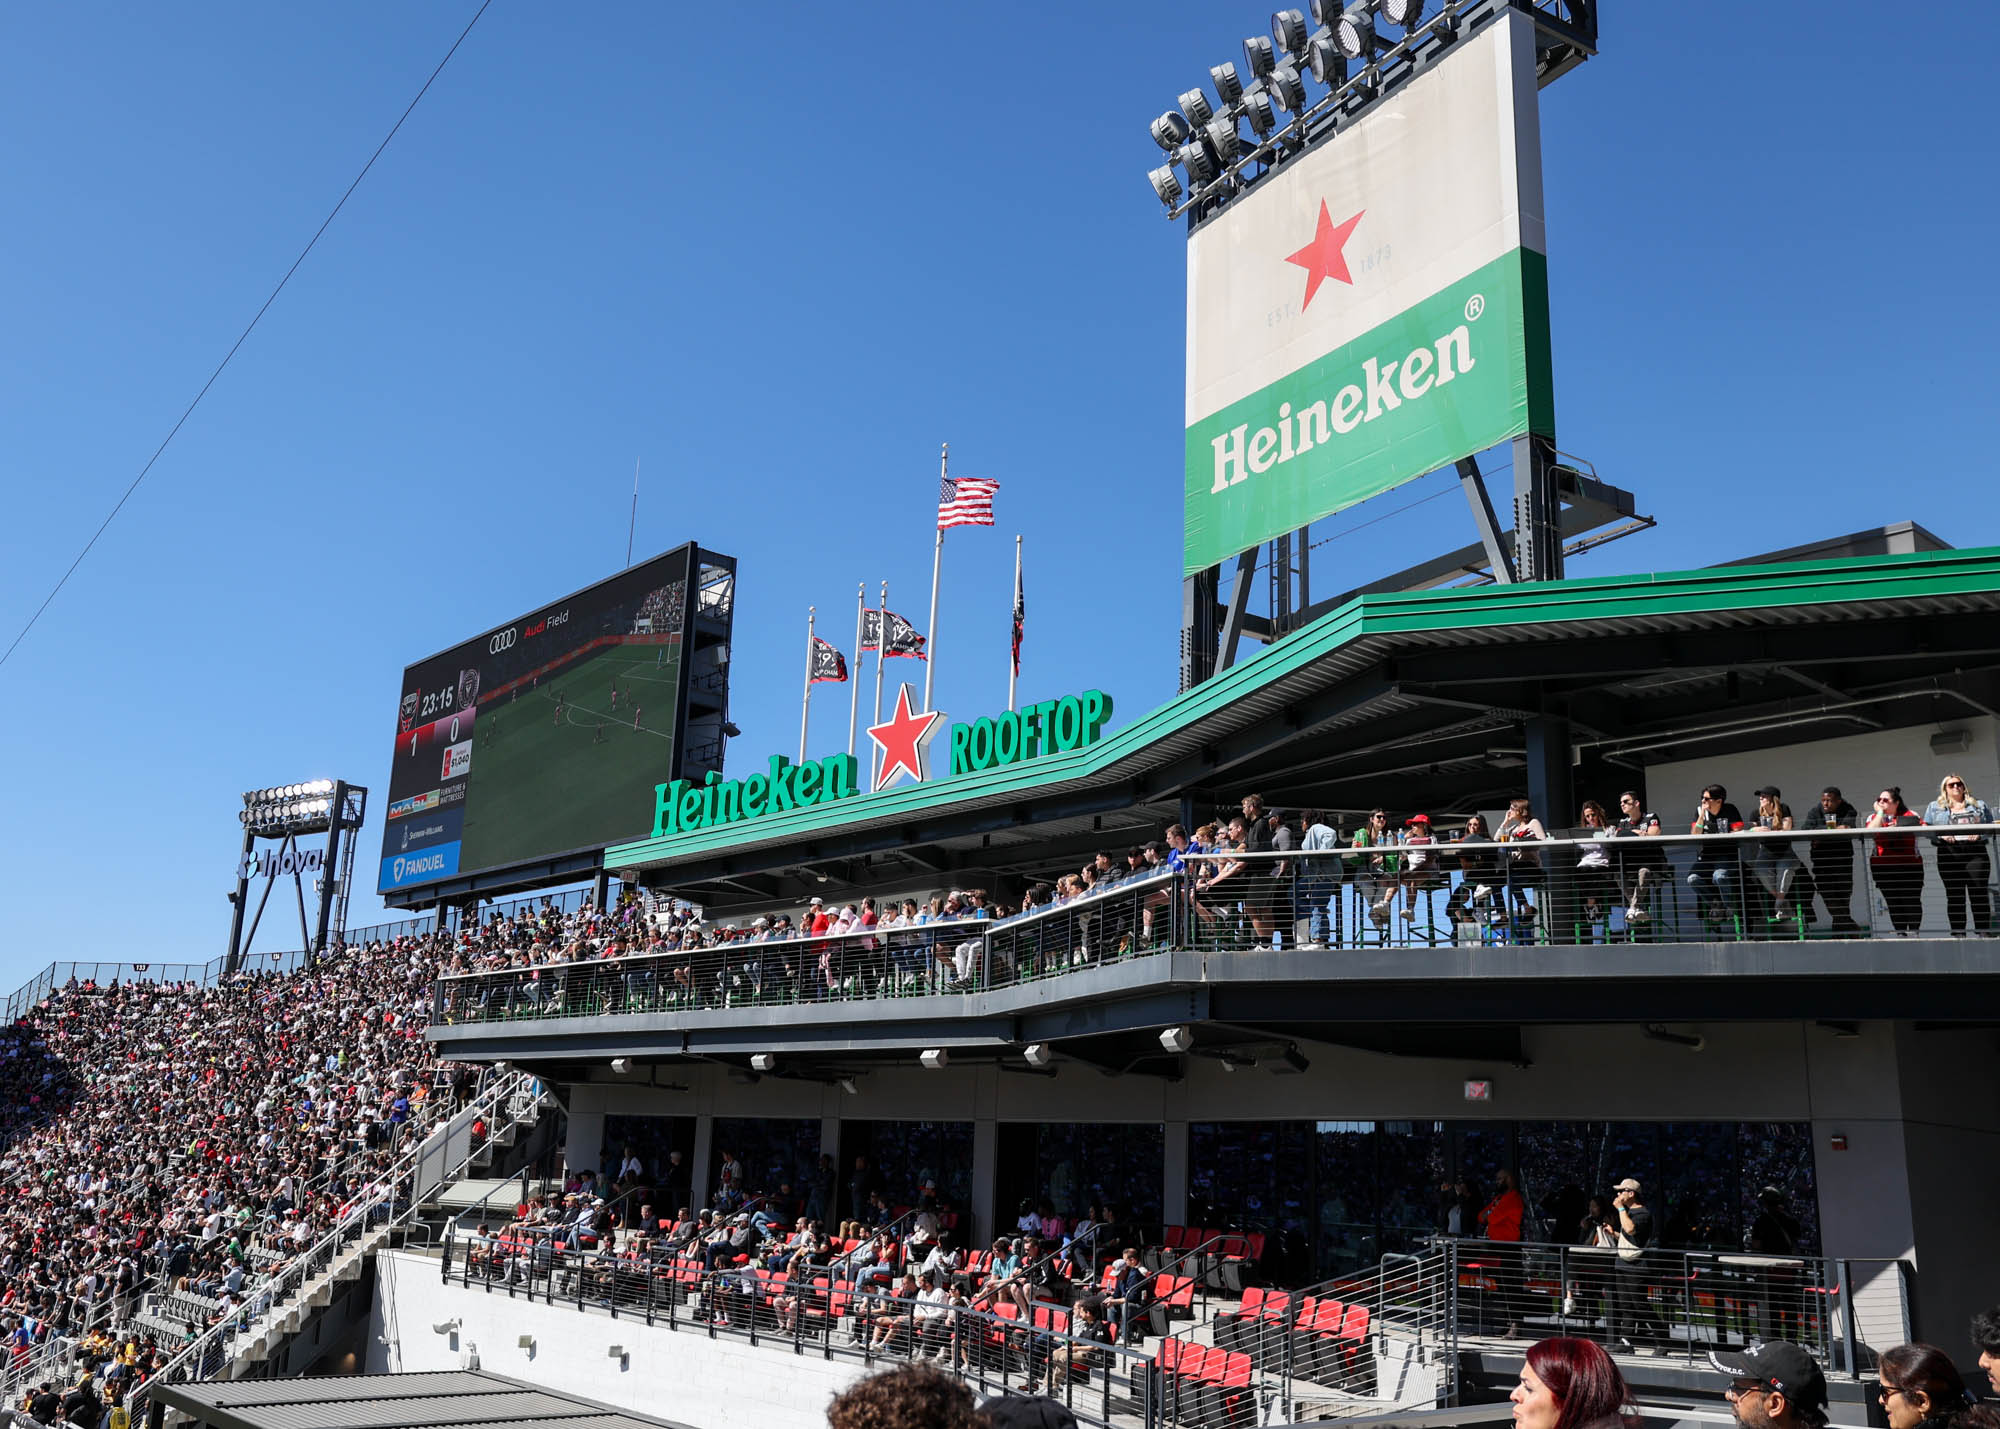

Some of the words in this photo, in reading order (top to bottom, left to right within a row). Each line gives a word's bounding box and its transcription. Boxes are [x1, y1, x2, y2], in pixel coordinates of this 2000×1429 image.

[1210, 325, 1476, 494] Heineken
[524, 620, 545, 639] Audi
[546, 609, 569, 629] Field
[421, 685, 454, 717] 23:15
[411, 733, 417, 756] 1
[450, 717, 459, 742] 0
[951, 689, 1108, 775] ROOFTOP
[651, 752, 858, 838] Heineken
[405, 854, 445, 876] FANDUEL
